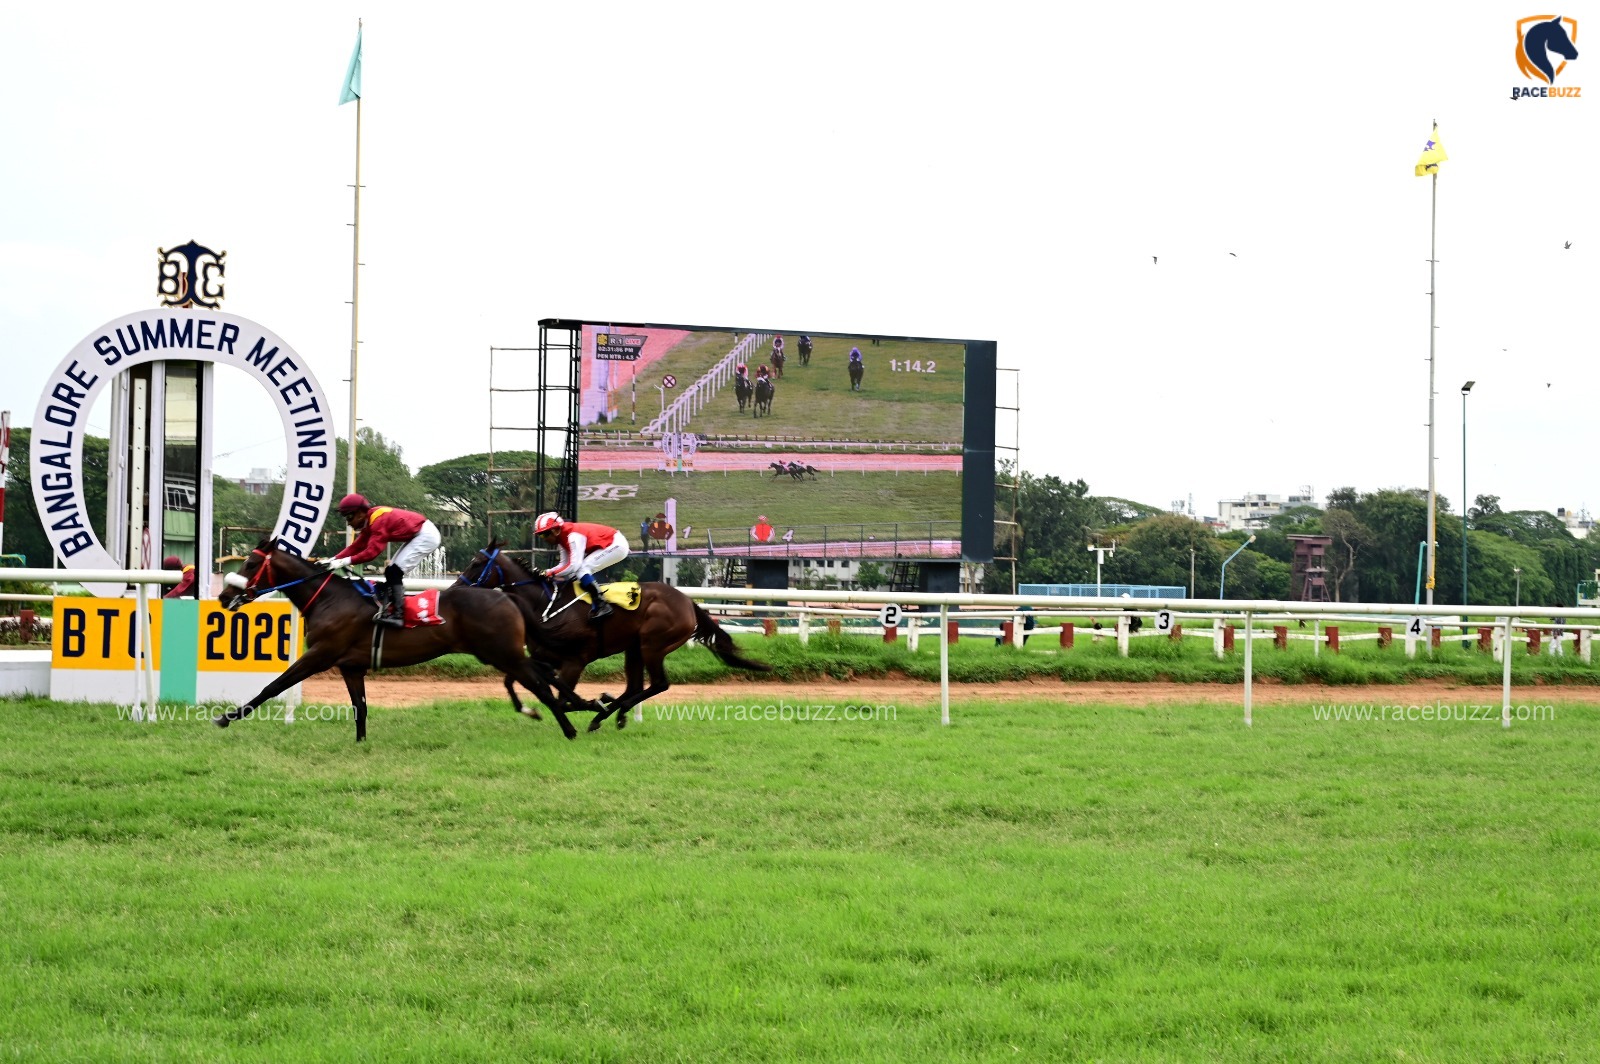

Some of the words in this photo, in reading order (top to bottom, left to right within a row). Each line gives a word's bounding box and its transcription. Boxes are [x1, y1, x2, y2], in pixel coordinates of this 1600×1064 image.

[889, 359, 936, 373] 1:14.2
[40, 360, 99, 558] BANGALORE
[93, 318, 240, 366] SUMMER
[245, 336, 327, 469] MEETING
[682, 526, 692, 539] 1
[782, 529, 795, 541] 4
[885, 606, 897, 624] 2
[1159, 612, 1169, 629] 3
[1410, 618, 1421, 635] 4
[206, 611, 291, 661] 2026
